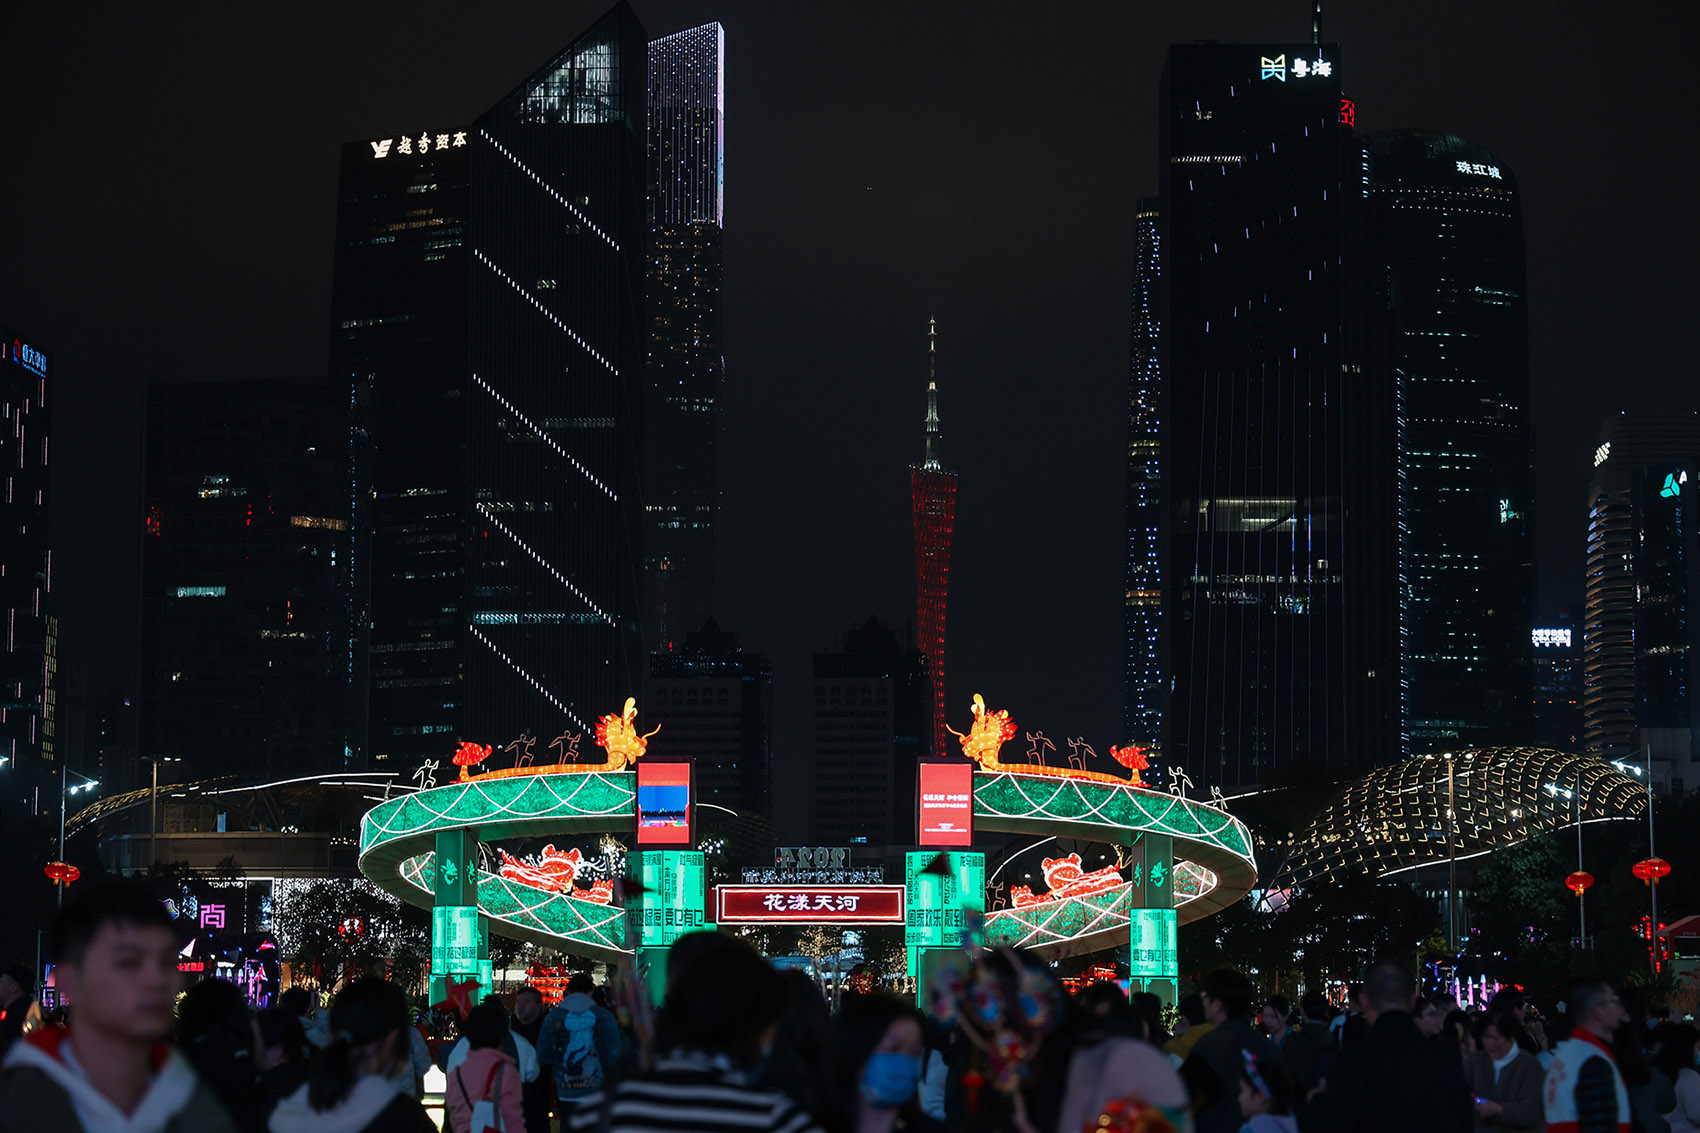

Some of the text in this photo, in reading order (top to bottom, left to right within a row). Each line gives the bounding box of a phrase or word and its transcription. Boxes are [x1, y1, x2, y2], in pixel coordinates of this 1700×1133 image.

[397, 131, 468, 155] 越秀资本
[1455, 160, 1502, 180] 珠江城
[763, 893, 860, 912] 花漾天河
[665, 908, 704, 927] 要乜有乜
